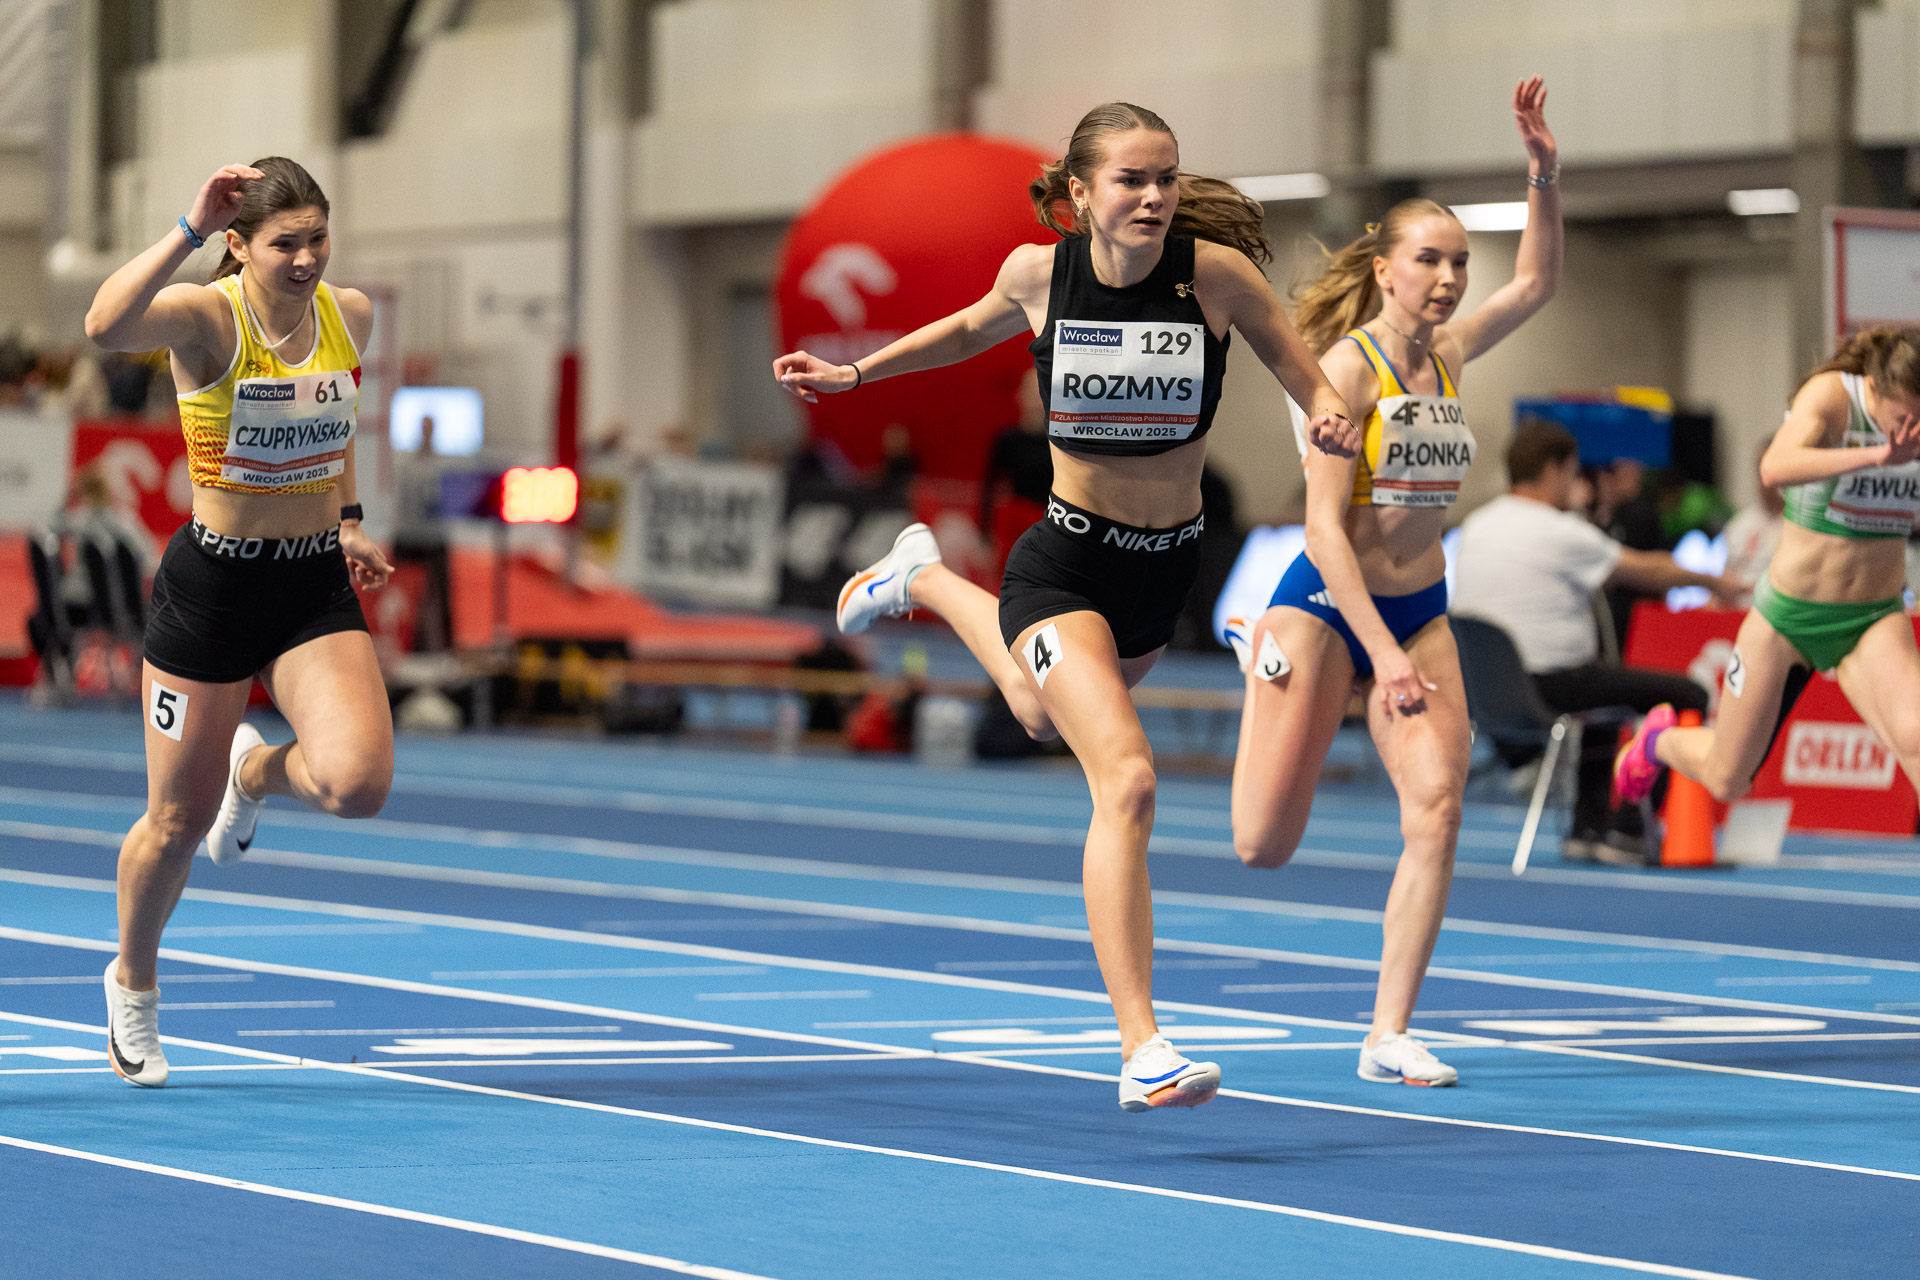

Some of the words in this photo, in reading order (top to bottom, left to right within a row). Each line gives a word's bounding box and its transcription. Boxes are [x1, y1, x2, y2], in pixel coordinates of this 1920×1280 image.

[1063, 329, 1120, 343] Wrocław
[1140, 331, 1192, 355] 129
[242, 385, 294, 399] Wrocław
[315, 380, 342, 403] 61
[1062, 373, 1193, 401] ROZMYS
[1054, 413, 1071, 421] PZLA
[235, 418, 350, 449] CZUPRYŃSKA
[1072, 426, 1143, 437] WROCŁAW
[1145, 427, 1177, 437] 2025
[1386, 442, 1471, 466] PŁONKA
[306, 466, 329, 478] 2025
[201, 527, 264, 559] PRO
[273, 525, 339, 560] NIKE
[1102, 526, 1176, 552] NIKE
[1034, 633, 1053, 674] 4
[155, 689, 177, 731] 5
